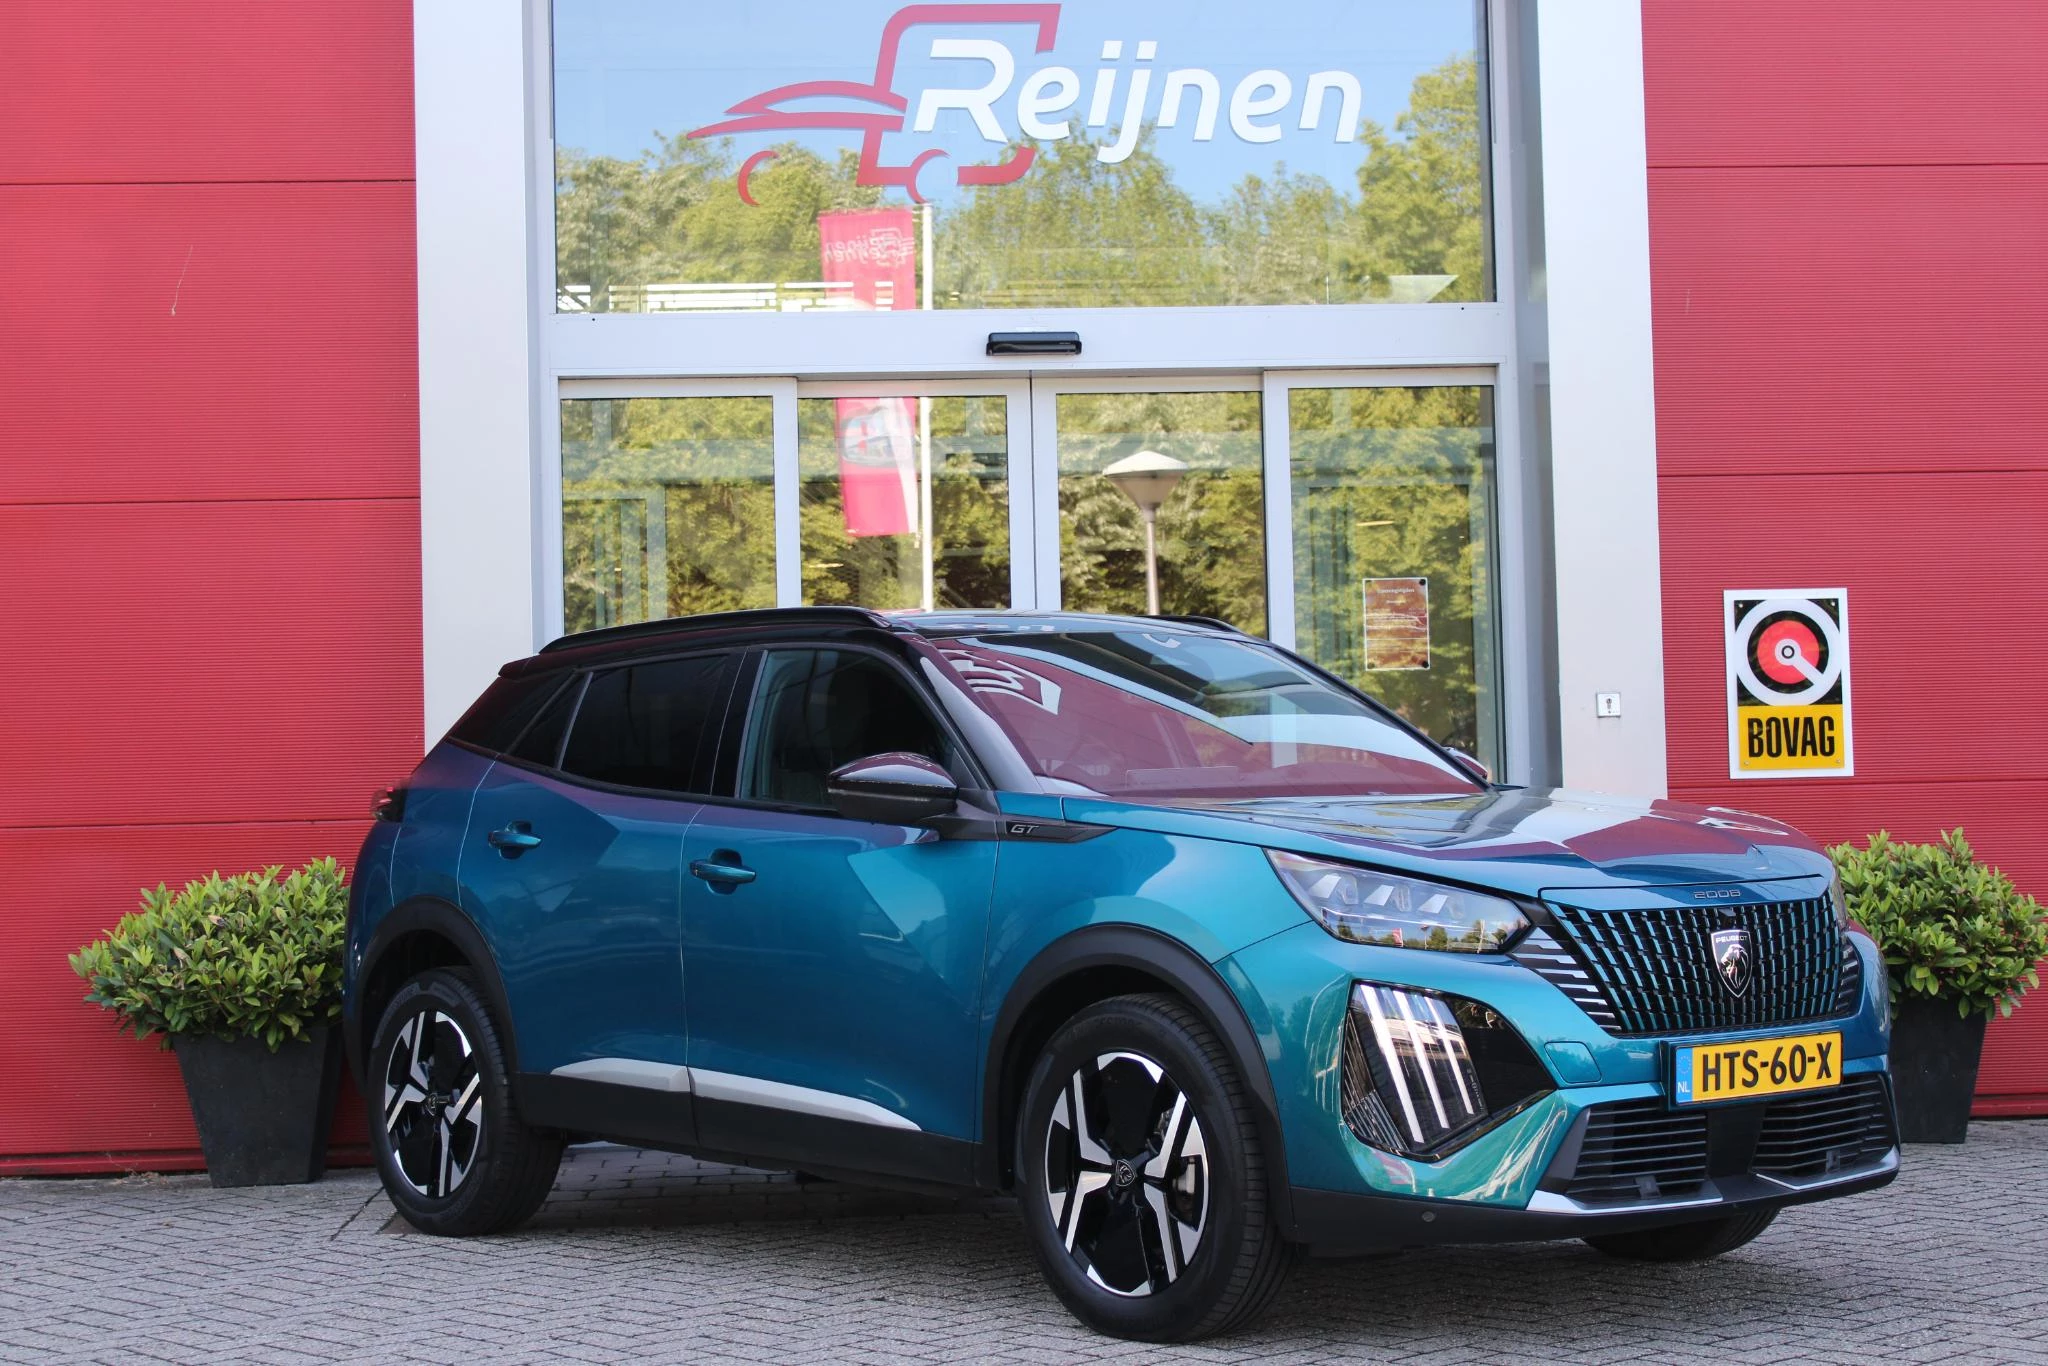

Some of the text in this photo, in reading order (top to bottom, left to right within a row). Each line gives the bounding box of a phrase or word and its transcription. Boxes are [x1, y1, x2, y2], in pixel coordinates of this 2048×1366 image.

[912, 39, 1362, 164] Reijnen
[1747, 715, 1835, 758] BOVAG
[1010, 824, 1040, 834] GT
[1693, 889, 1741, 899] 2008
[1715, 935, 1748, 944] PEUGEOT
[1702, 1041, 1833, 1093] HTS-60-X
[1677, 1081, 1691, 1094] NL
